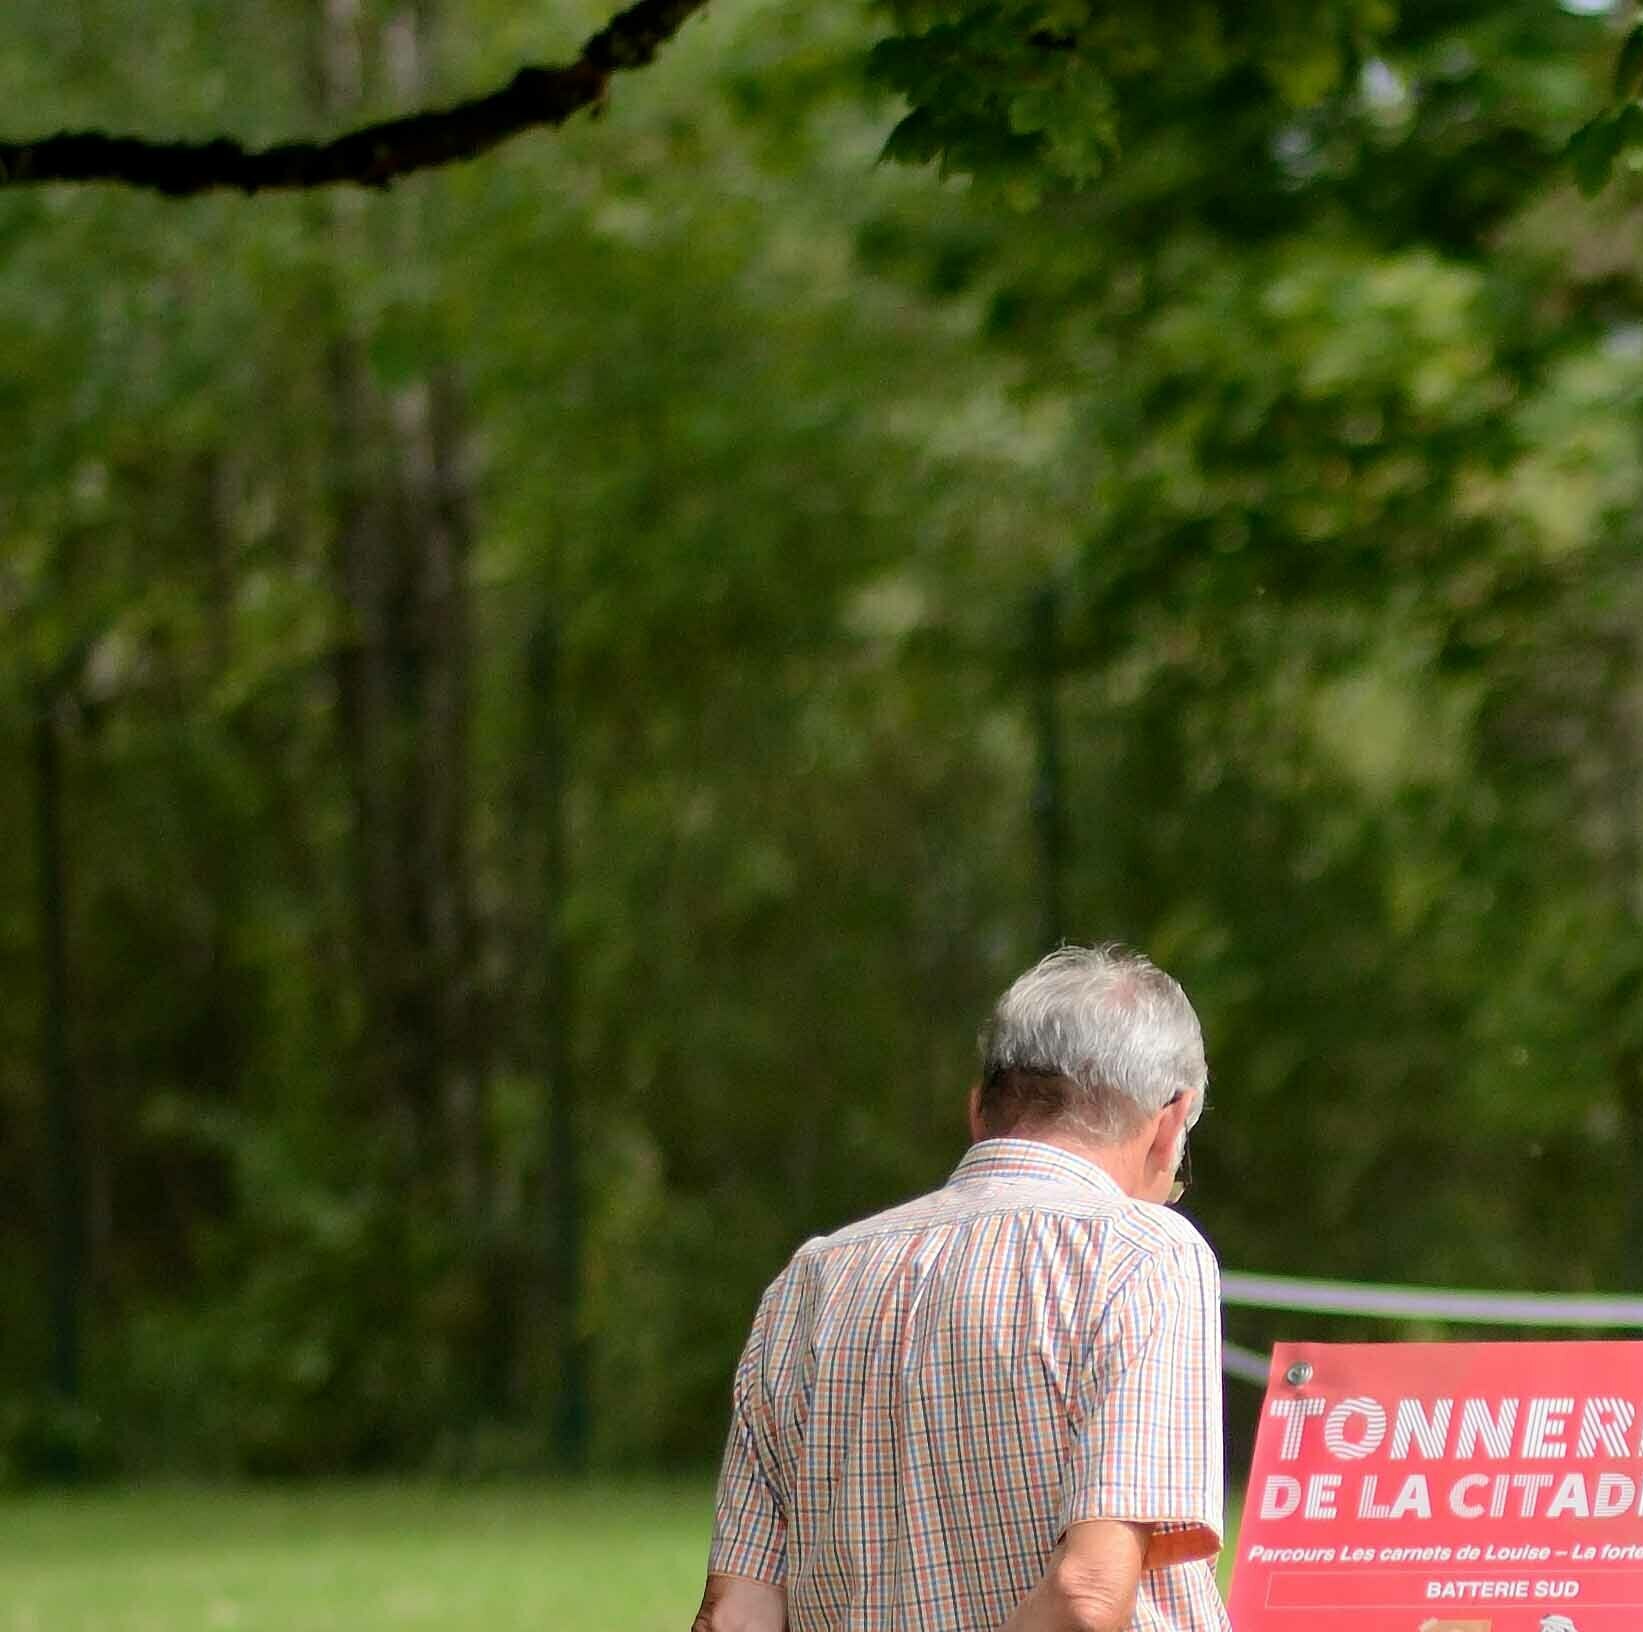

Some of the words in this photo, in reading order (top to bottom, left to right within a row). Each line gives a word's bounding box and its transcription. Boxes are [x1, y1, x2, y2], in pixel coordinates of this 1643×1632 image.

[1260, 1473, 1342, 1519] DE
[1357, 1473, 1432, 1519] LA
[1248, 1545, 1335, 1562] Parcours
[1340, 1545, 1374, 1561] Les
[1380, 1545, 1451, 1561] carnets
[1456, 1544, 1481, 1560] de
[1485, 1543, 1551, 1561] Louise
[1572, 1544, 1596, 1560] La
[1426, 1581, 1528, 1599] BATTERIE
[1535, 1580, 1579, 1598] SUD
